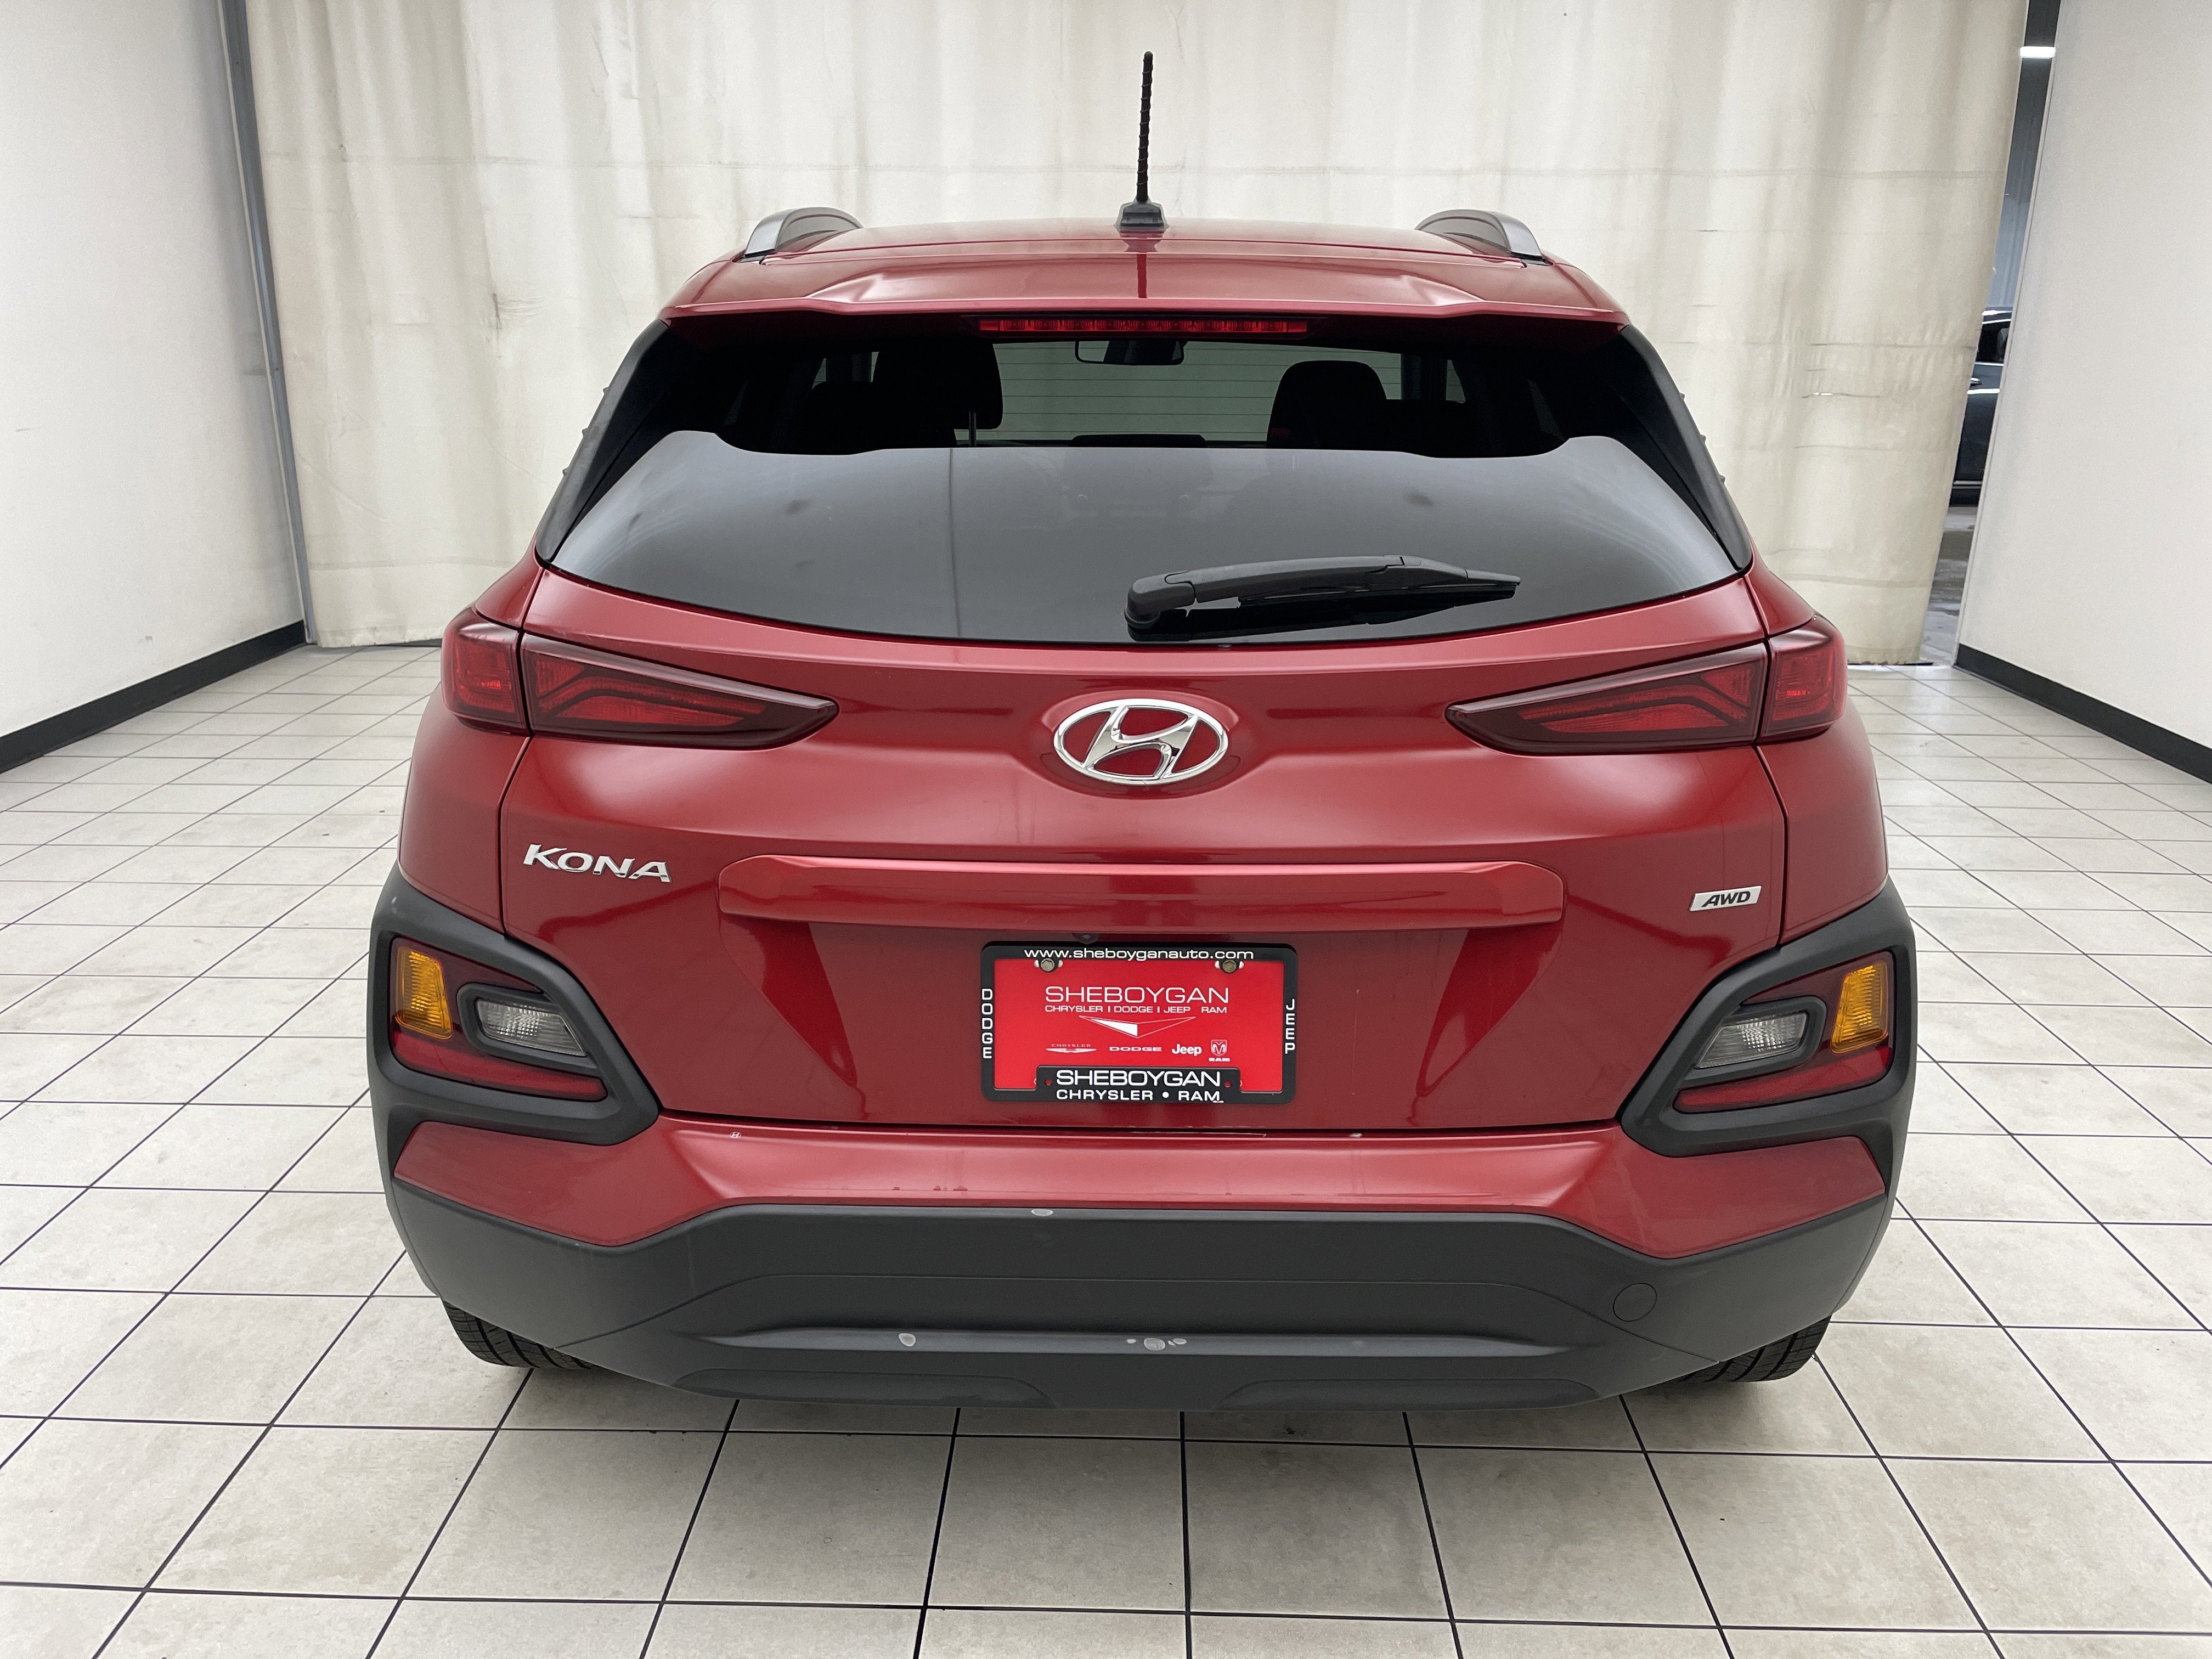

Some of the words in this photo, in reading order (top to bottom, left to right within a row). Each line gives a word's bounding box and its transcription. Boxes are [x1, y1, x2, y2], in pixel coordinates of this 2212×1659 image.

[523, 843, 672, 883] KONA
[1701, 891, 1751, 907] AWD
[1024, 947, 1254, 961] www.sheboyganauto.com
[1045, 986, 1229, 1003] SHEBOYGAN
[981, 989, 993, 1059] DODGE
[1284, 999, 1296, 1054] JEEP
[1171, 1043, 1202, 1056] Jeep
[1056, 1070, 1221, 1087] SHEBOYGAN
[1056, 1090, 1153, 1101] CHRYSLER
[1178, 1091, 1220, 1102] RAM
